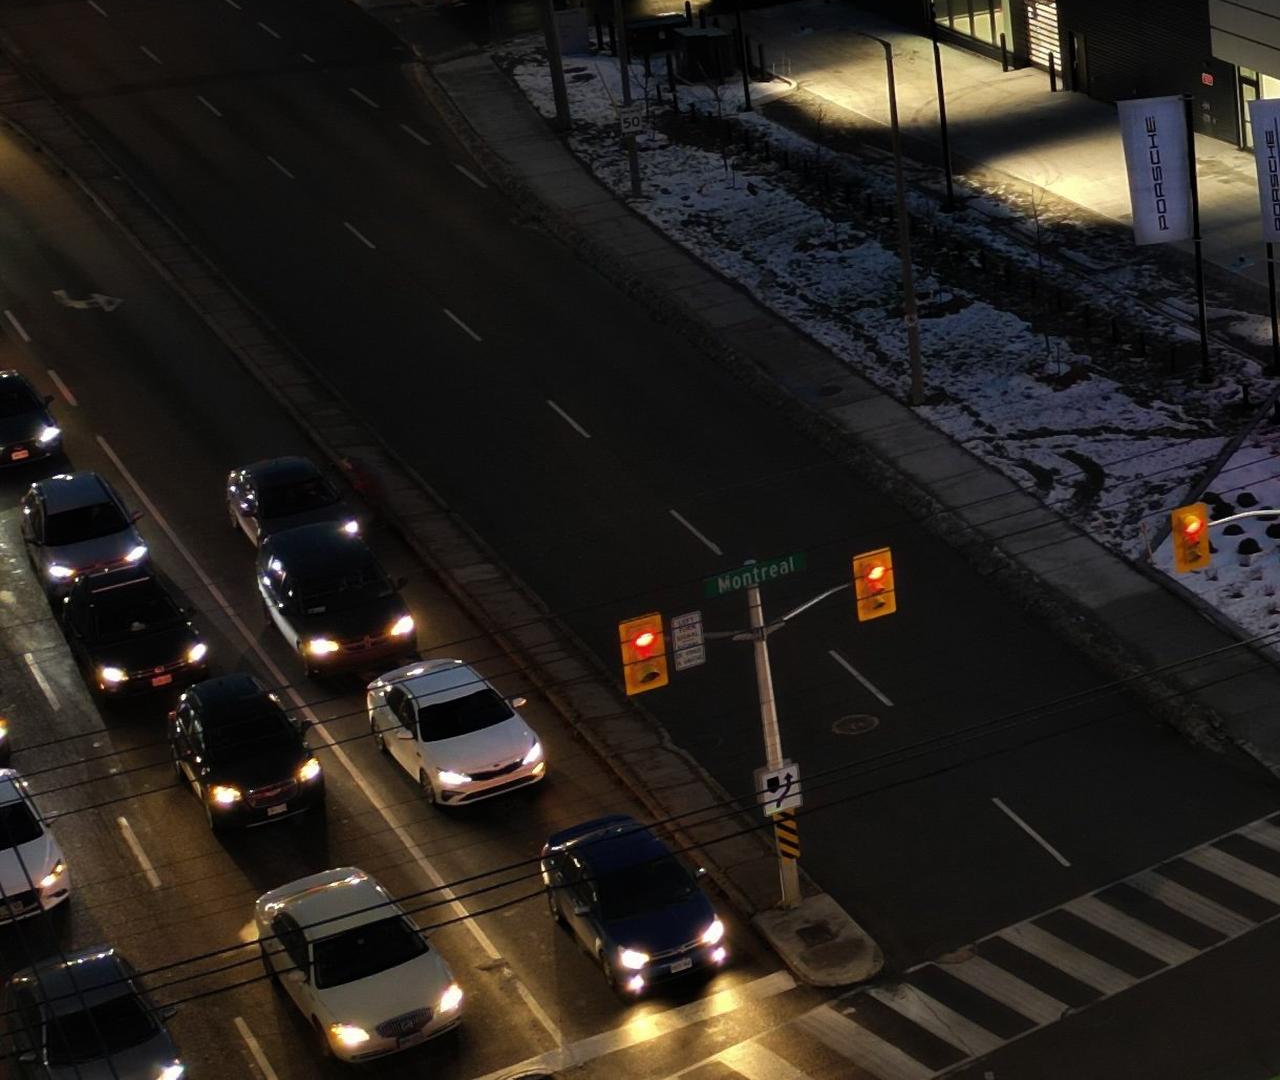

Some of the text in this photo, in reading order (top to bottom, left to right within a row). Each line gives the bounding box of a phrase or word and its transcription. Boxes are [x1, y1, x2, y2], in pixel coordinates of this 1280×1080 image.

[623, 116, 640, 129] 50
[1146, 116, 1169, 231] PORSCHE
[718, 557, 795, 594] Montreal
